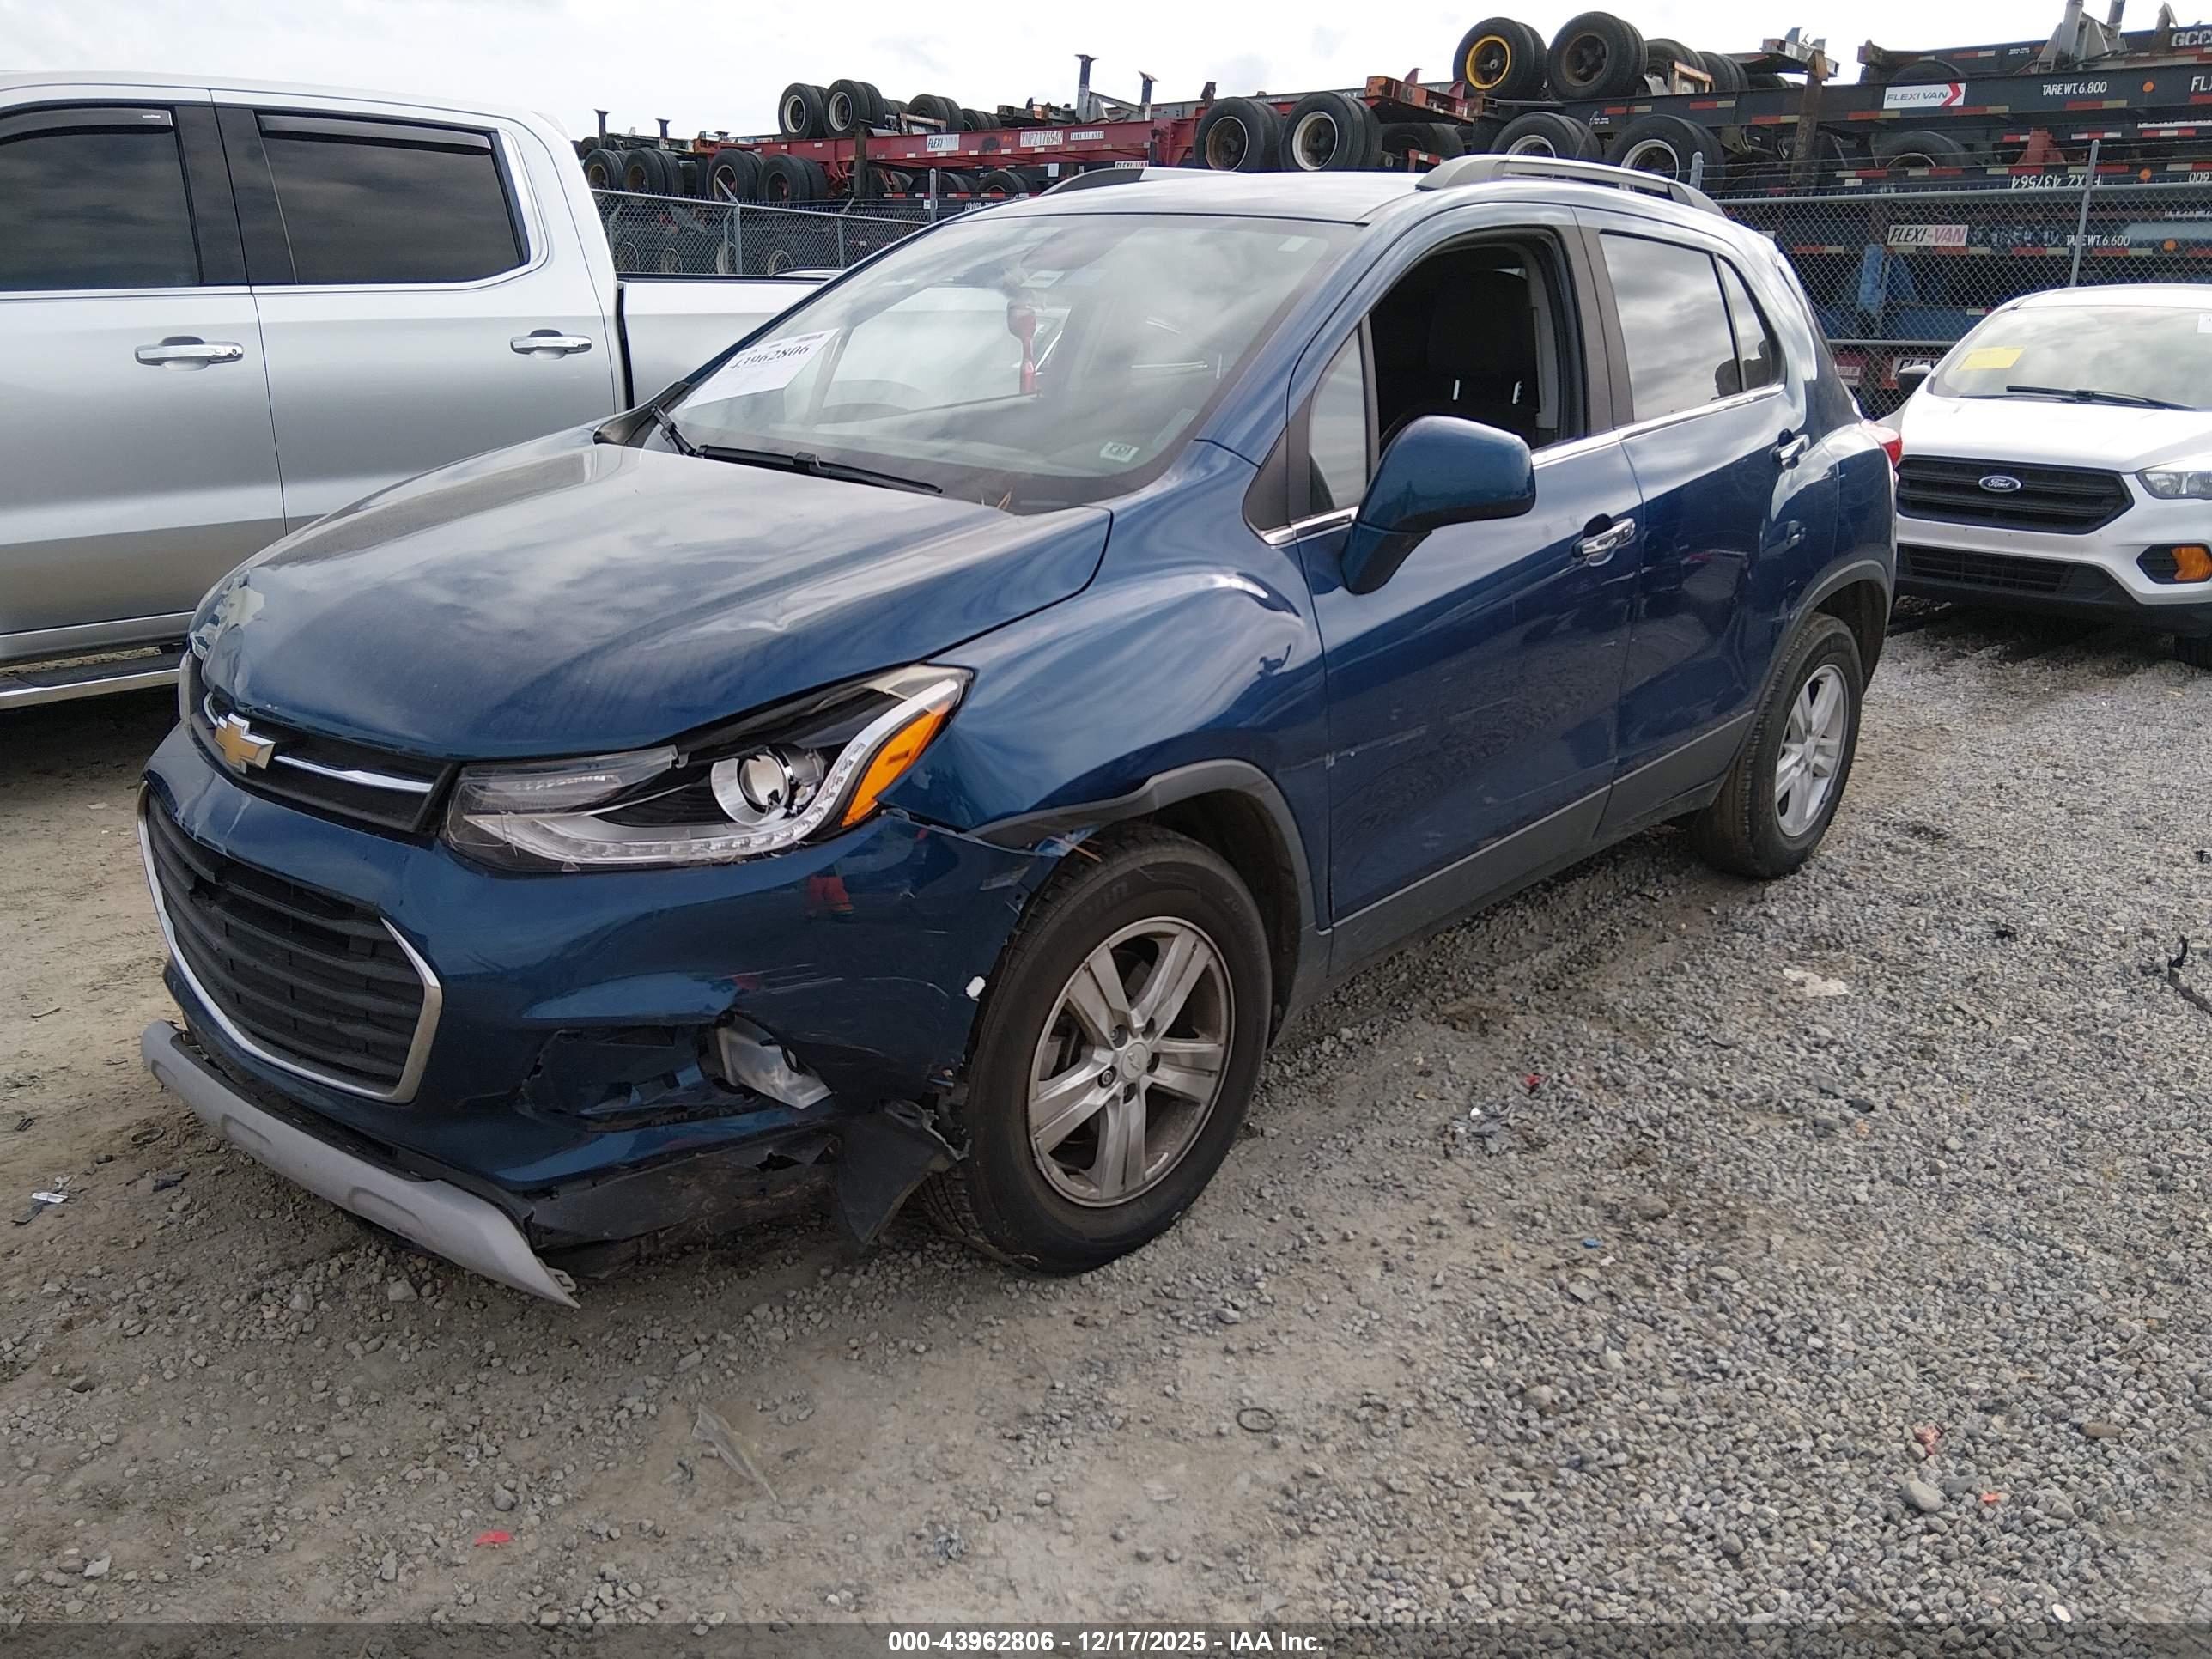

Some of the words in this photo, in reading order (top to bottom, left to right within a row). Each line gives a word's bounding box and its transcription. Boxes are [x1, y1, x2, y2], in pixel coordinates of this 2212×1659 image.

[1886, 93, 1922, 101] FLEXI
[1923, 91, 1948, 100] VAN
[2011, 174, 2061, 189] 437564
[2068, 174, 2101, 187] FXZ
[1987, 478, 2011, 489] Ford
